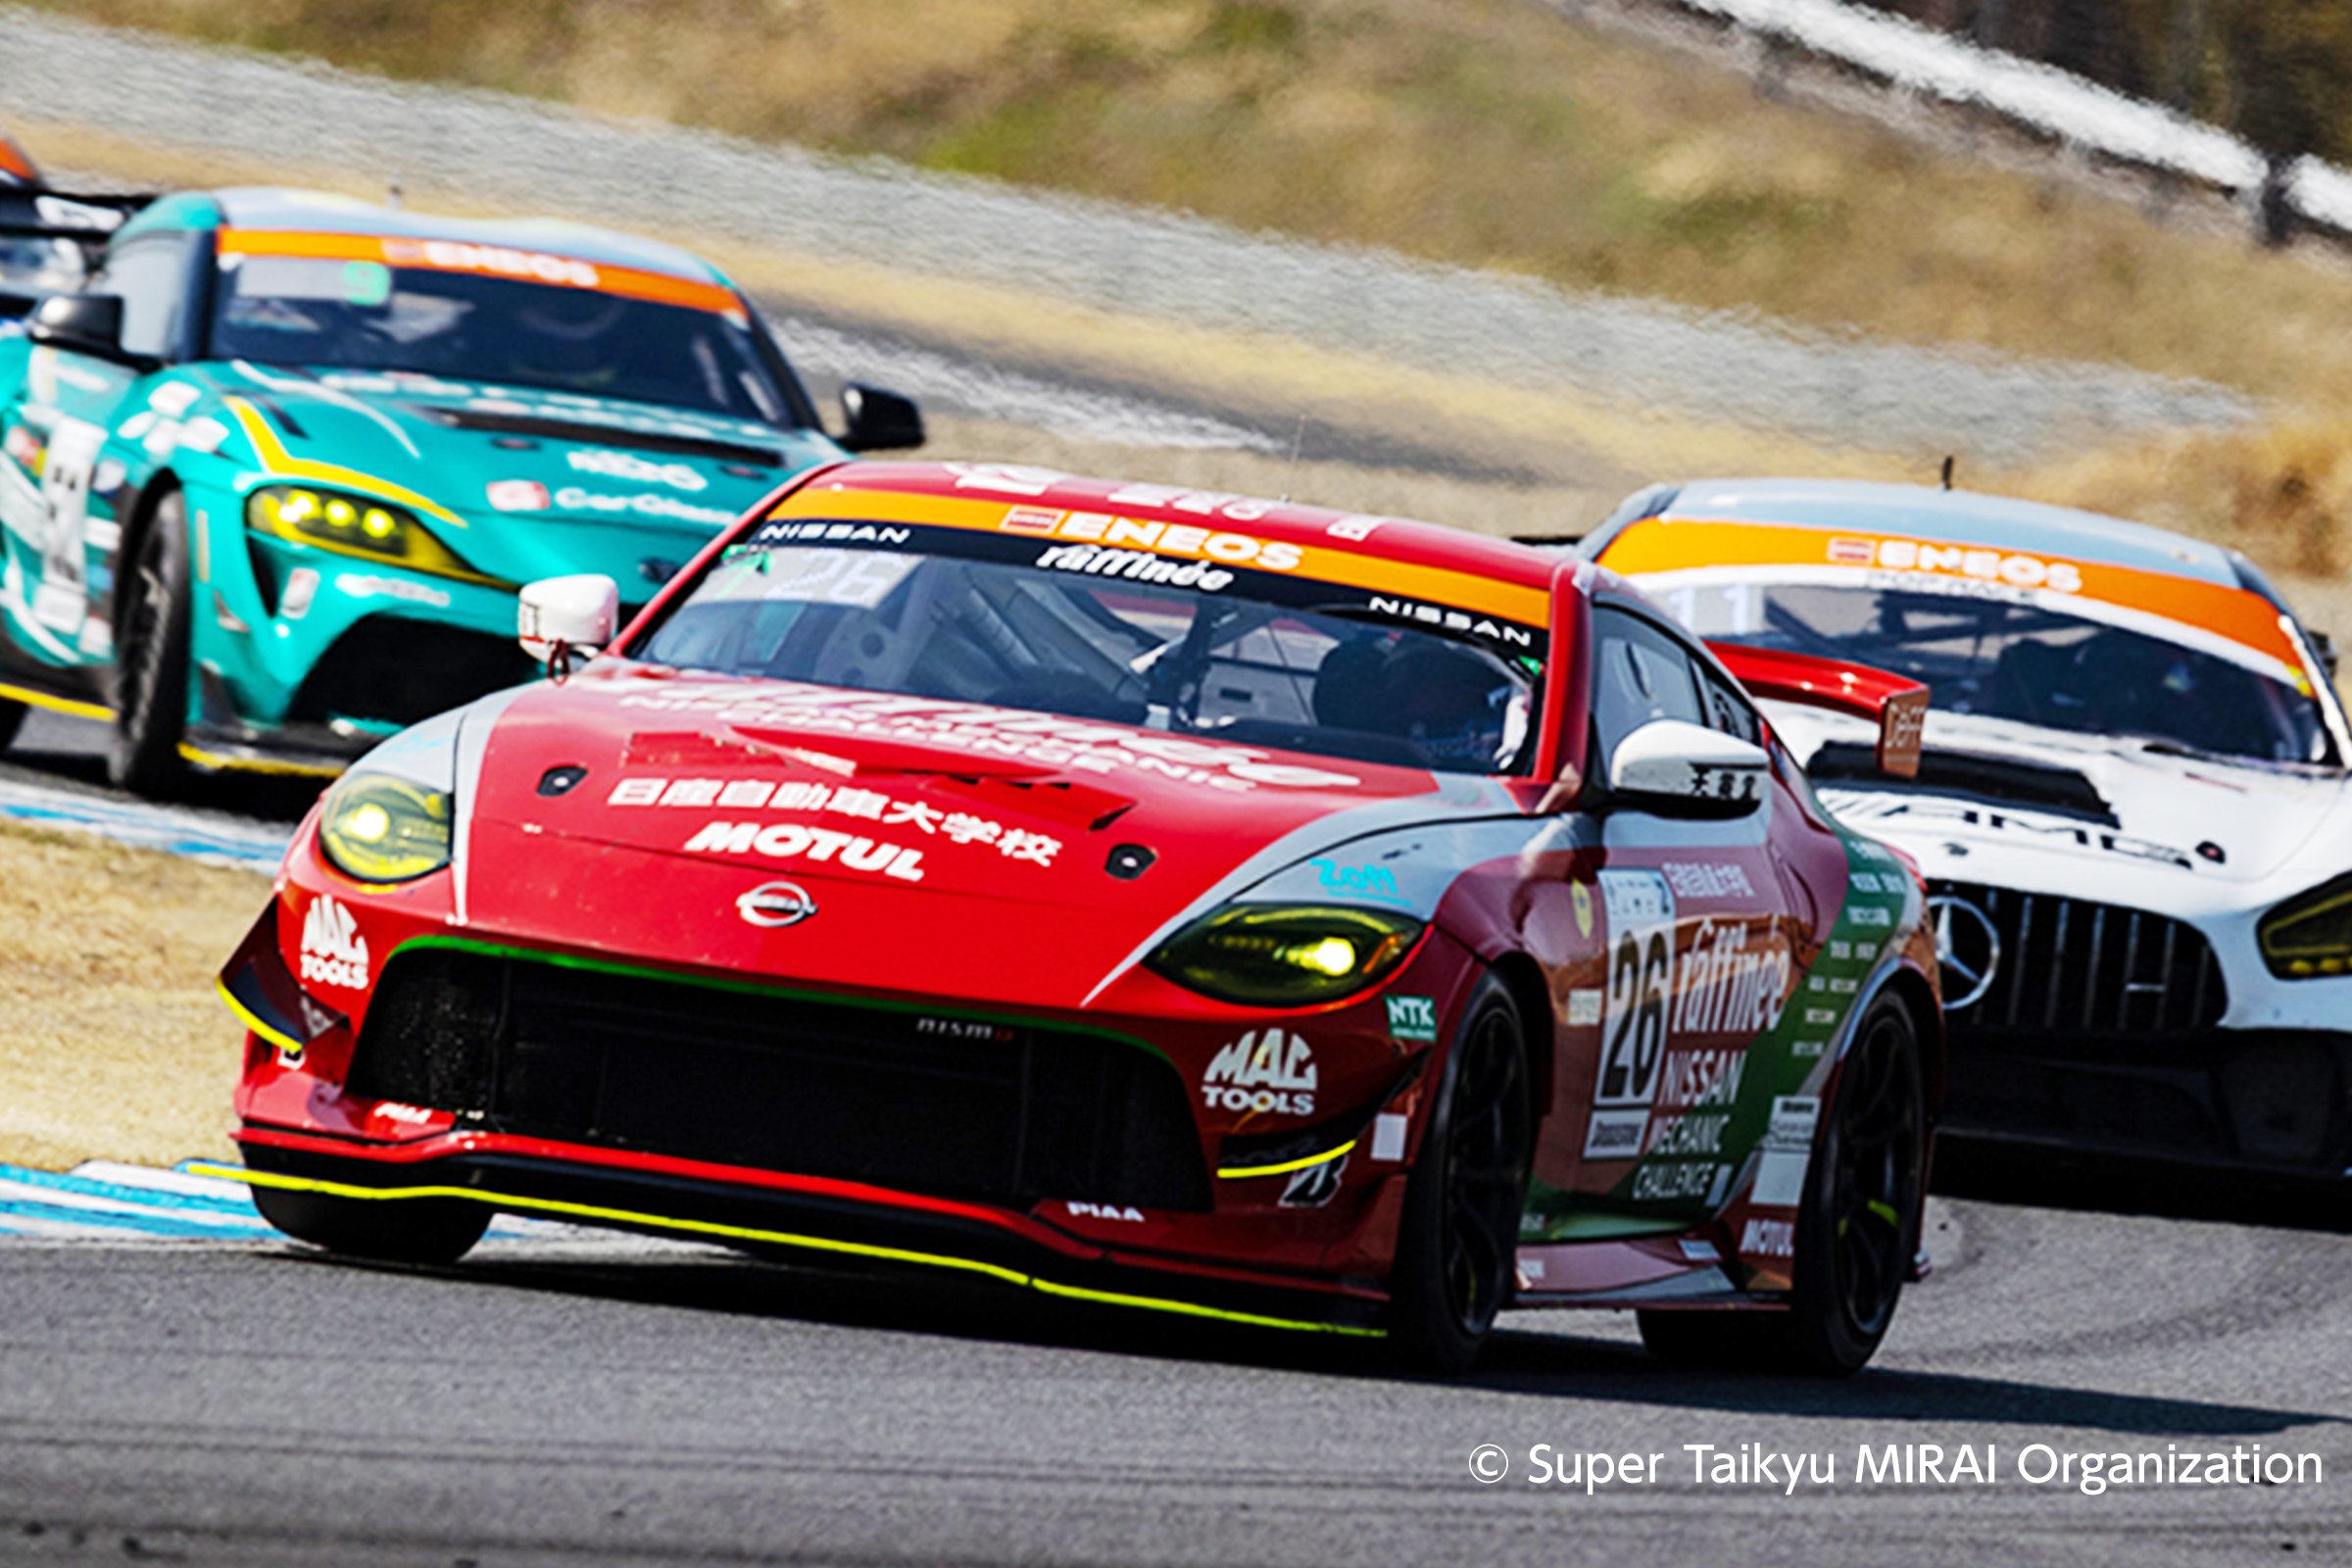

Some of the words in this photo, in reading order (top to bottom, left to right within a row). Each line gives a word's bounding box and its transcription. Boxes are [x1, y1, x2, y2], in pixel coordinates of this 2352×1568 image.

[760, 522, 910, 545] NISSAN
[1060, 511, 1303, 570] ENEOS
[1878, 539, 2082, 593] ENEOS
[1368, 596, 1532, 648] NISSAN
[685, 820, 925, 882] MOTUL
[300, 893, 369, 965] MAC
[300, 953, 369, 990] TOOLS
[1386, 997, 1435, 1027] NTK
[1599, 929, 1669, 1099] 26
[1202, 1027, 1318, 1091] MAC
[1656, 1050, 1747, 1106] NISSAN
[1200, 1084, 1315, 1116] TOOLS
[1643, 1114, 1730, 1154] MECHANIC
[1632, 1162, 1715, 1200] CHALLENGE
